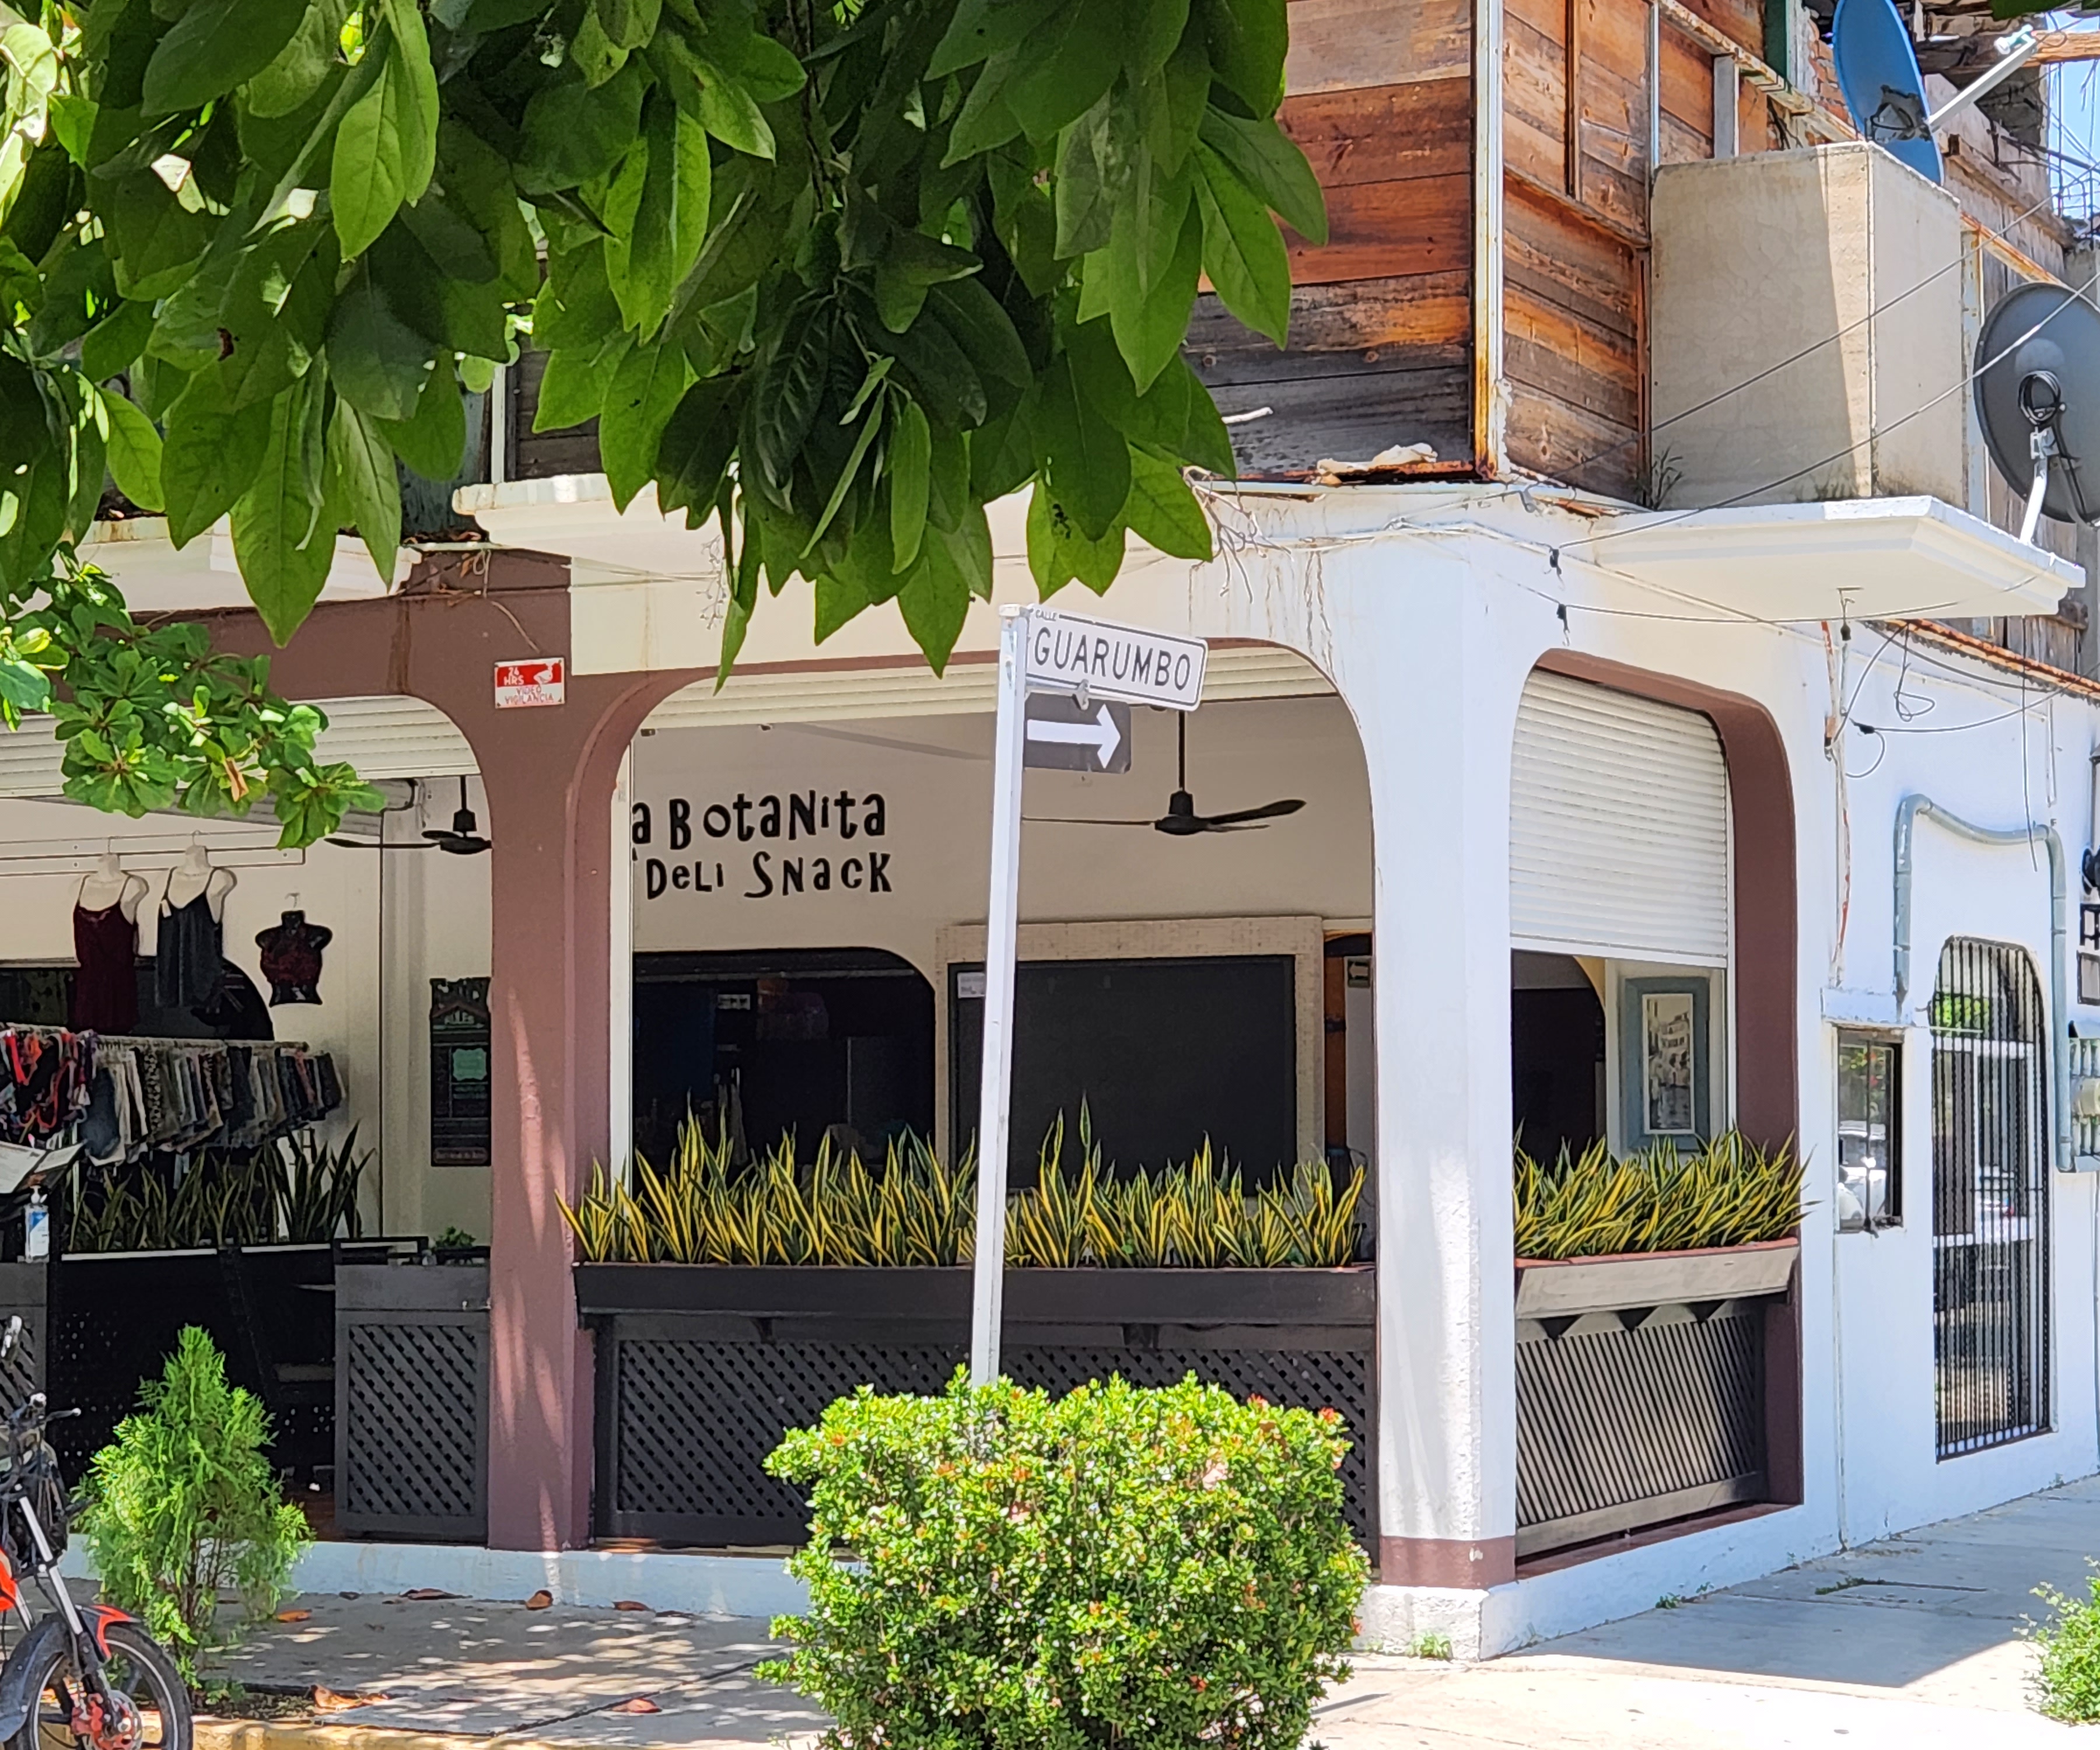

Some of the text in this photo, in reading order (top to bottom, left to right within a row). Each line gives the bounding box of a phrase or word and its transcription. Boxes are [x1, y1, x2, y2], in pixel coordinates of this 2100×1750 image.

[1035, 609, 1057, 622] CALLE
[1035, 627, 1191, 691] GUARUMBO
[503, 674, 524, 686] HRS
[516, 685, 541, 696] VIDEO
[505, 693, 554, 705] VIGILANCIA
